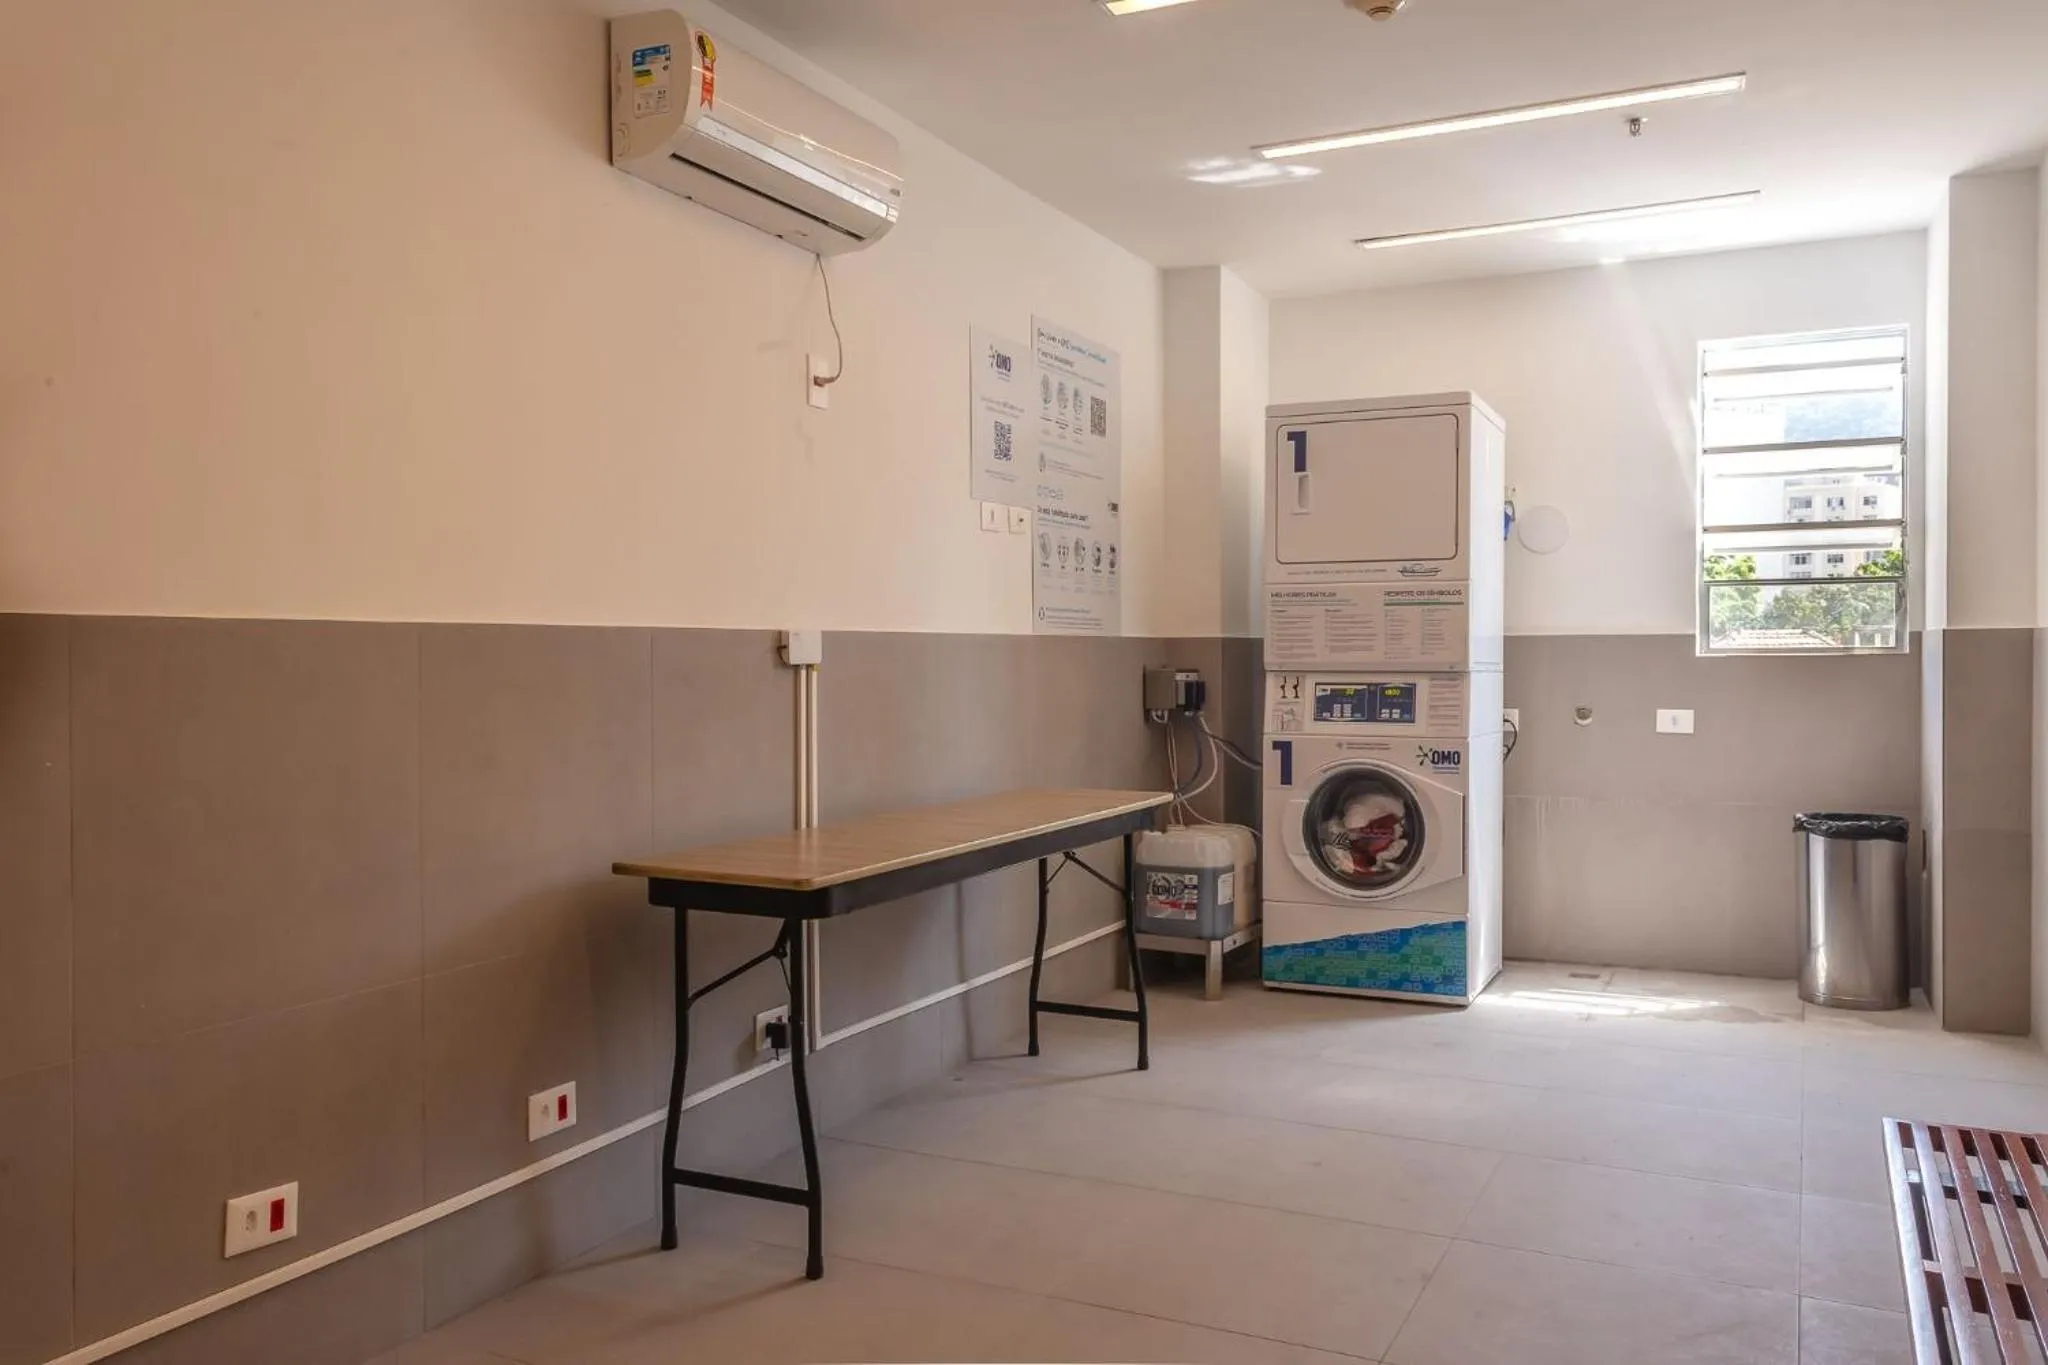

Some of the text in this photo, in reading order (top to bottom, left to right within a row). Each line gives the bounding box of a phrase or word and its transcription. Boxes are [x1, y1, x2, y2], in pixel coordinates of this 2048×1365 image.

[996, 353, 1011, 372] OMO
[1287, 431, 1307, 472] 1
[1271, 741, 1292, 785] 1
[1431, 750, 1461, 765] OMO
